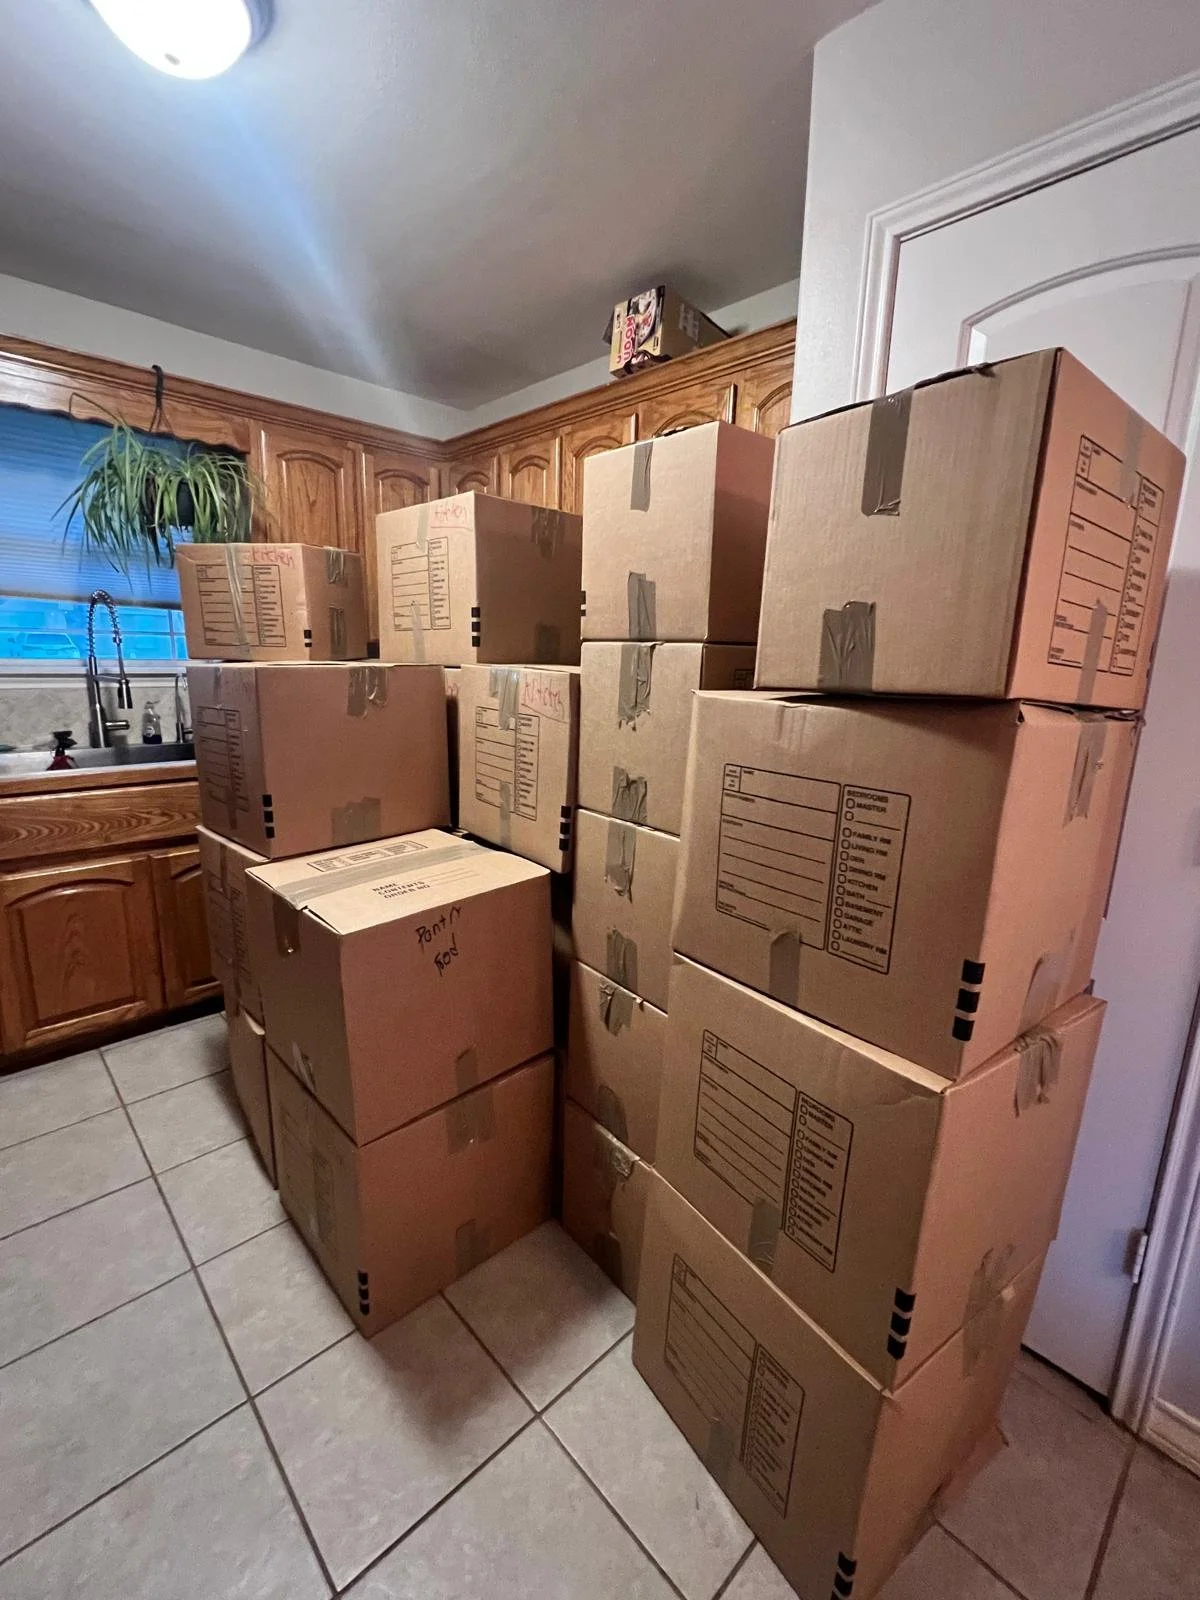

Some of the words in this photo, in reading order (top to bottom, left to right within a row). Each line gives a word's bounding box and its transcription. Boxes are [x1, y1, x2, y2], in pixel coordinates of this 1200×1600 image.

[856, 803, 887, 813] MASTER
[372, 883, 397, 892] NAME
[378, 881, 425, 895] CONTENTS
[847, 879, 878, 892] KITCHEN
[384, 889, 416, 899] ORDER
[846, 890, 865, 900] BATH
